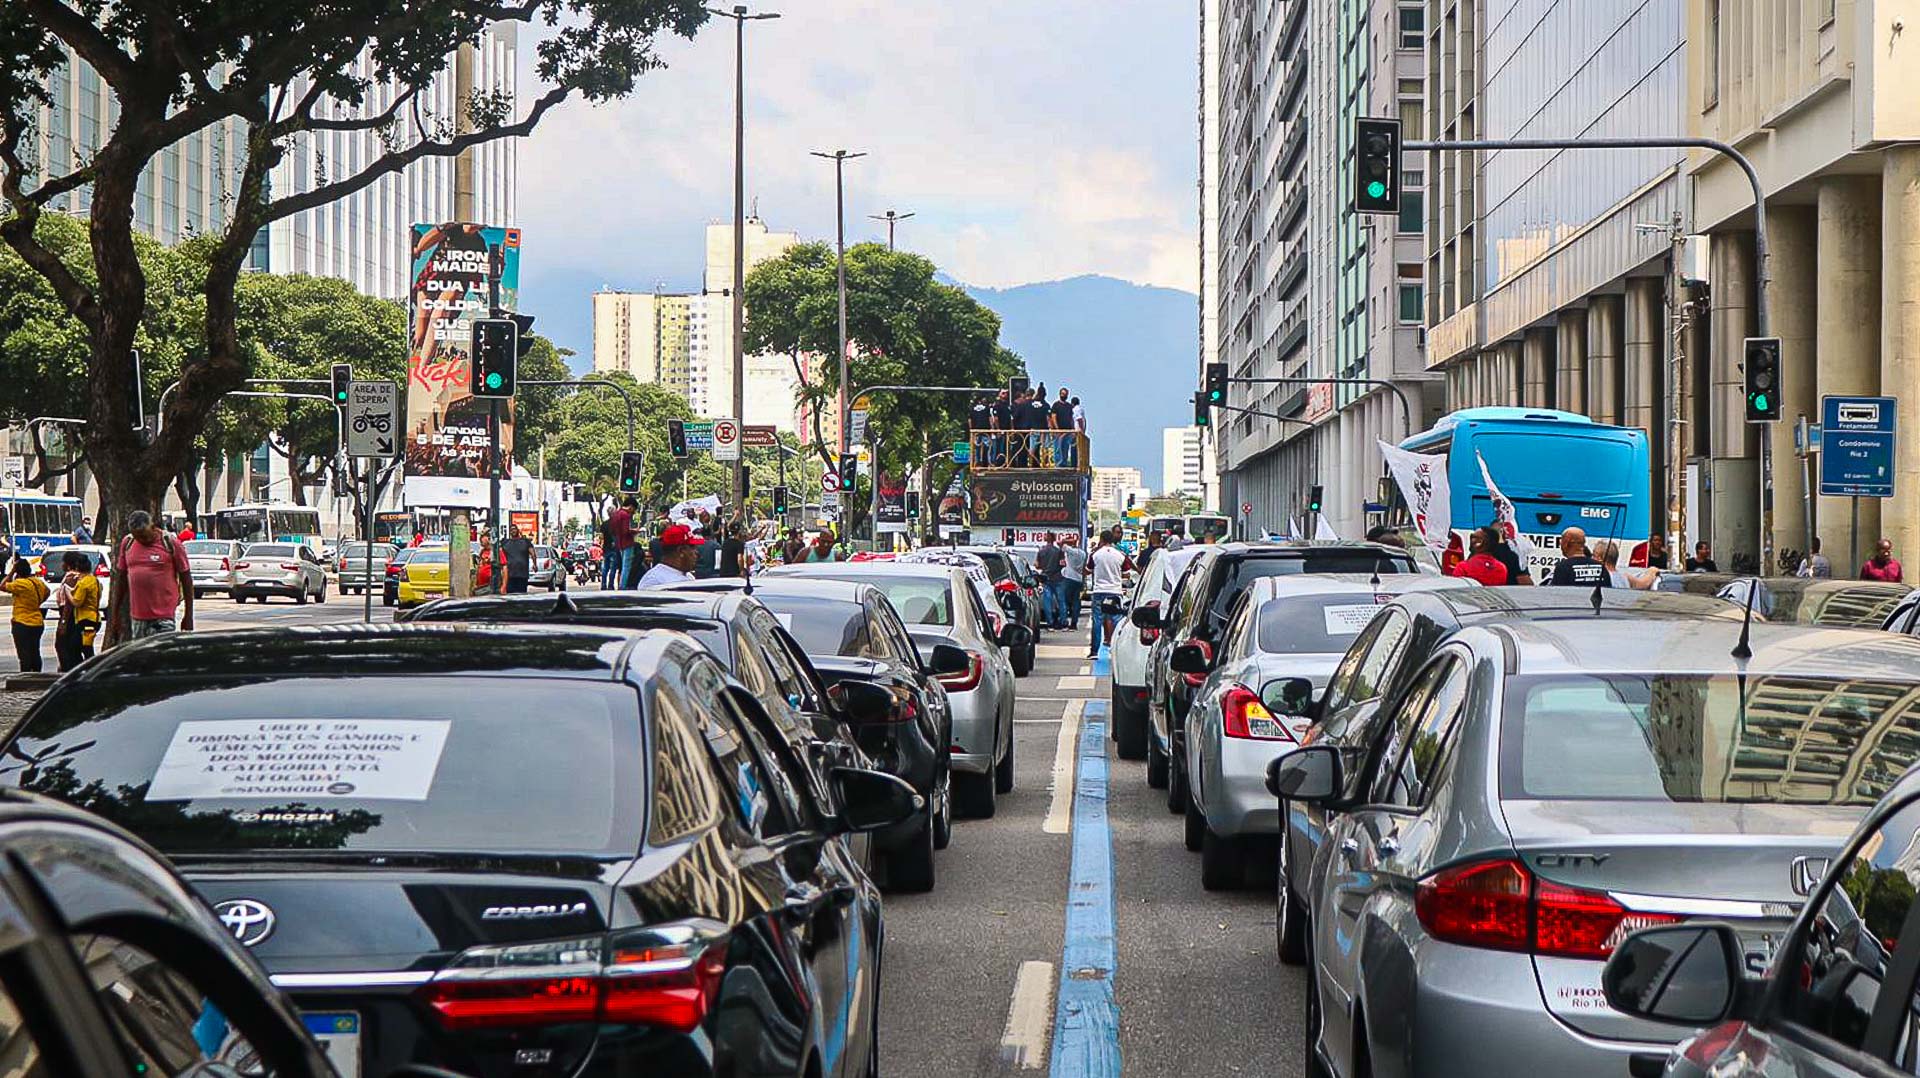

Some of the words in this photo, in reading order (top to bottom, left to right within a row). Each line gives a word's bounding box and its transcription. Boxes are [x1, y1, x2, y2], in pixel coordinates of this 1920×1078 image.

[446, 250, 489, 262] IRON
[432, 261, 500, 275] MAIDE
[426, 280, 464, 292] DUA
[381, 385, 392, 394] DE
[356, 395, 389, 404] ESPERA
[438, 426, 486, 436] VENDAS
[416, 433, 428, 445] 5
[432, 434, 455, 446] DE
[1016, 510, 1070, 521] ALUGO
[1581, 507, 1610, 518] EMG
[258, 724, 309, 732] UBER
[199, 743, 285, 752] AUMENTE
[292, 743, 318, 751] OS
[324, 743, 402, 751] GANHOS
[209, 754, 249, 762] DOS
[202, 764, 215, 772] A
[222, 763, 327, 772] CATEGORIA
[1536, 853, 1611, 867] CITY
[482, 903, 587, 919] COROLLA
[1571, 998, 1591, 1008] Rio
